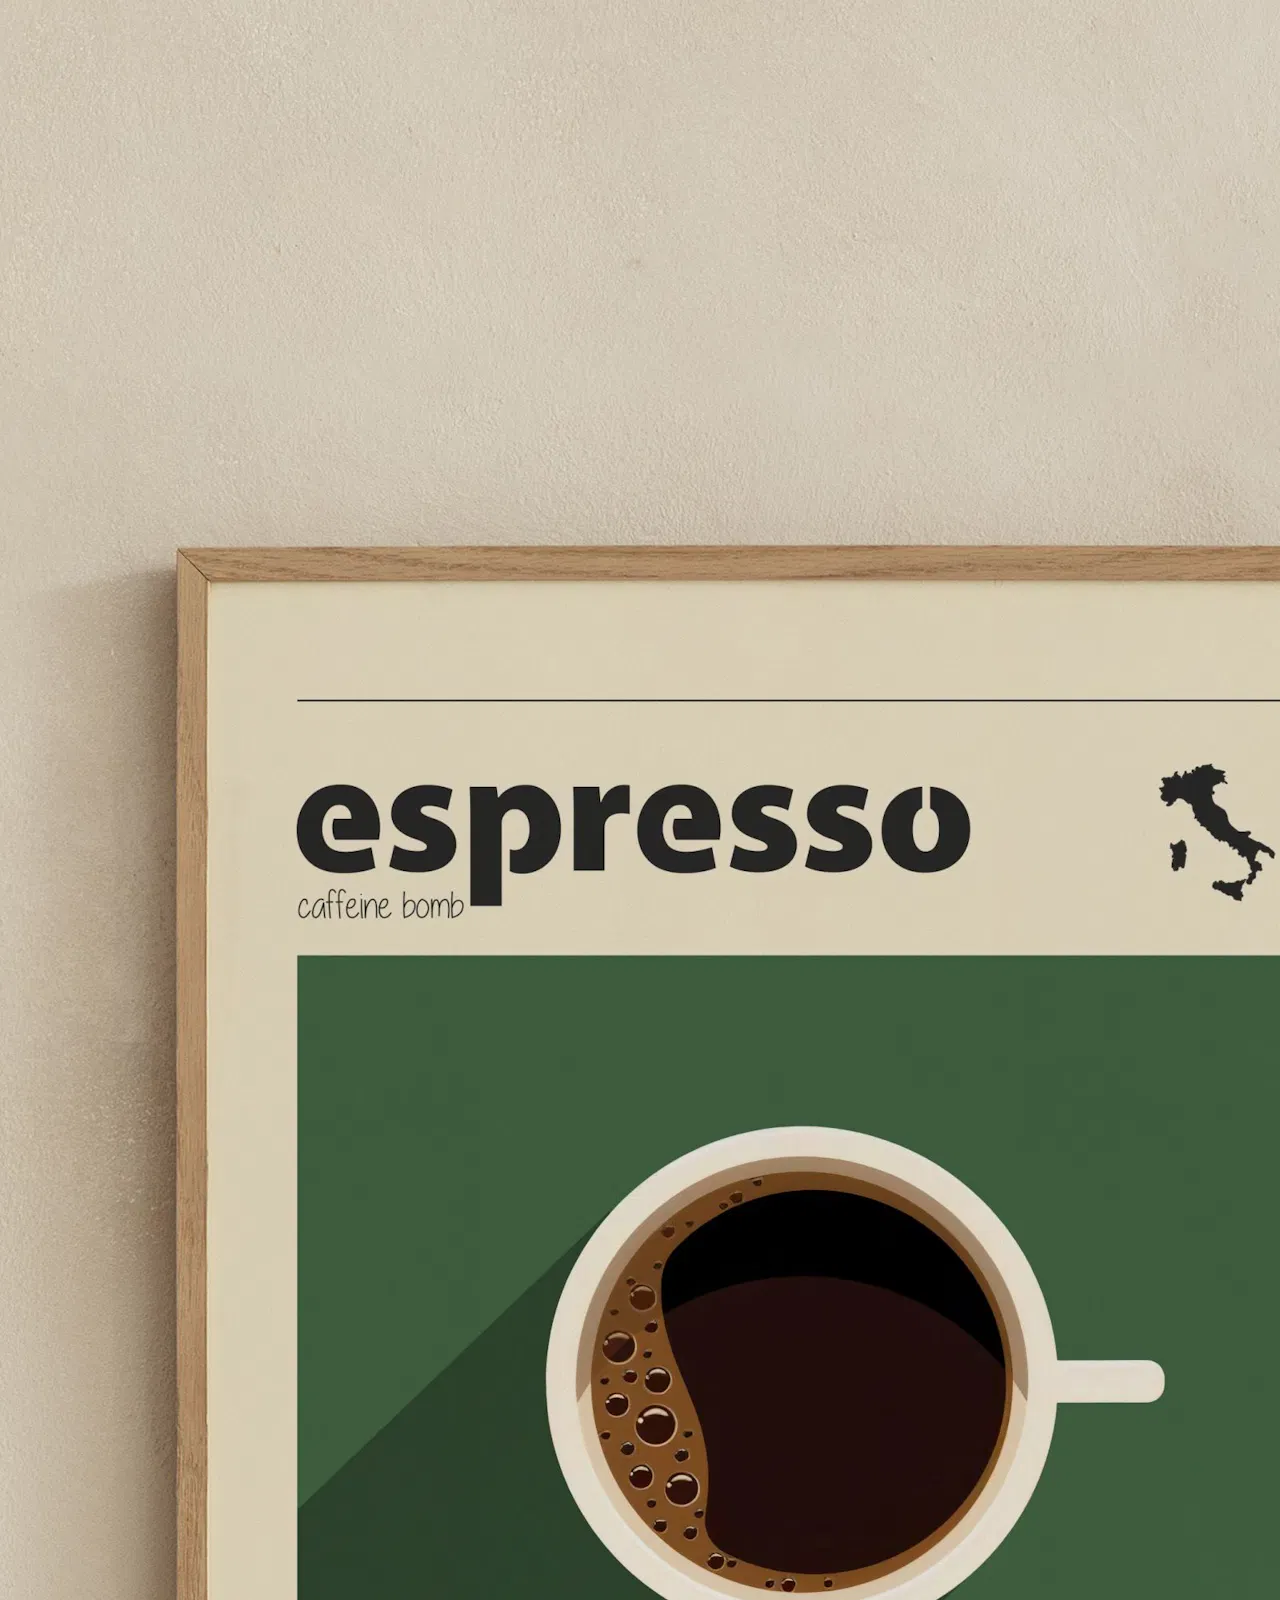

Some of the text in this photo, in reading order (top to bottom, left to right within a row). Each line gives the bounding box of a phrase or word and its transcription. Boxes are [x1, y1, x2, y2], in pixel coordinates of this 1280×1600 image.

[297, 784, 971, 906] espresso
[298, 888, 464, 919] caffeine bomb
